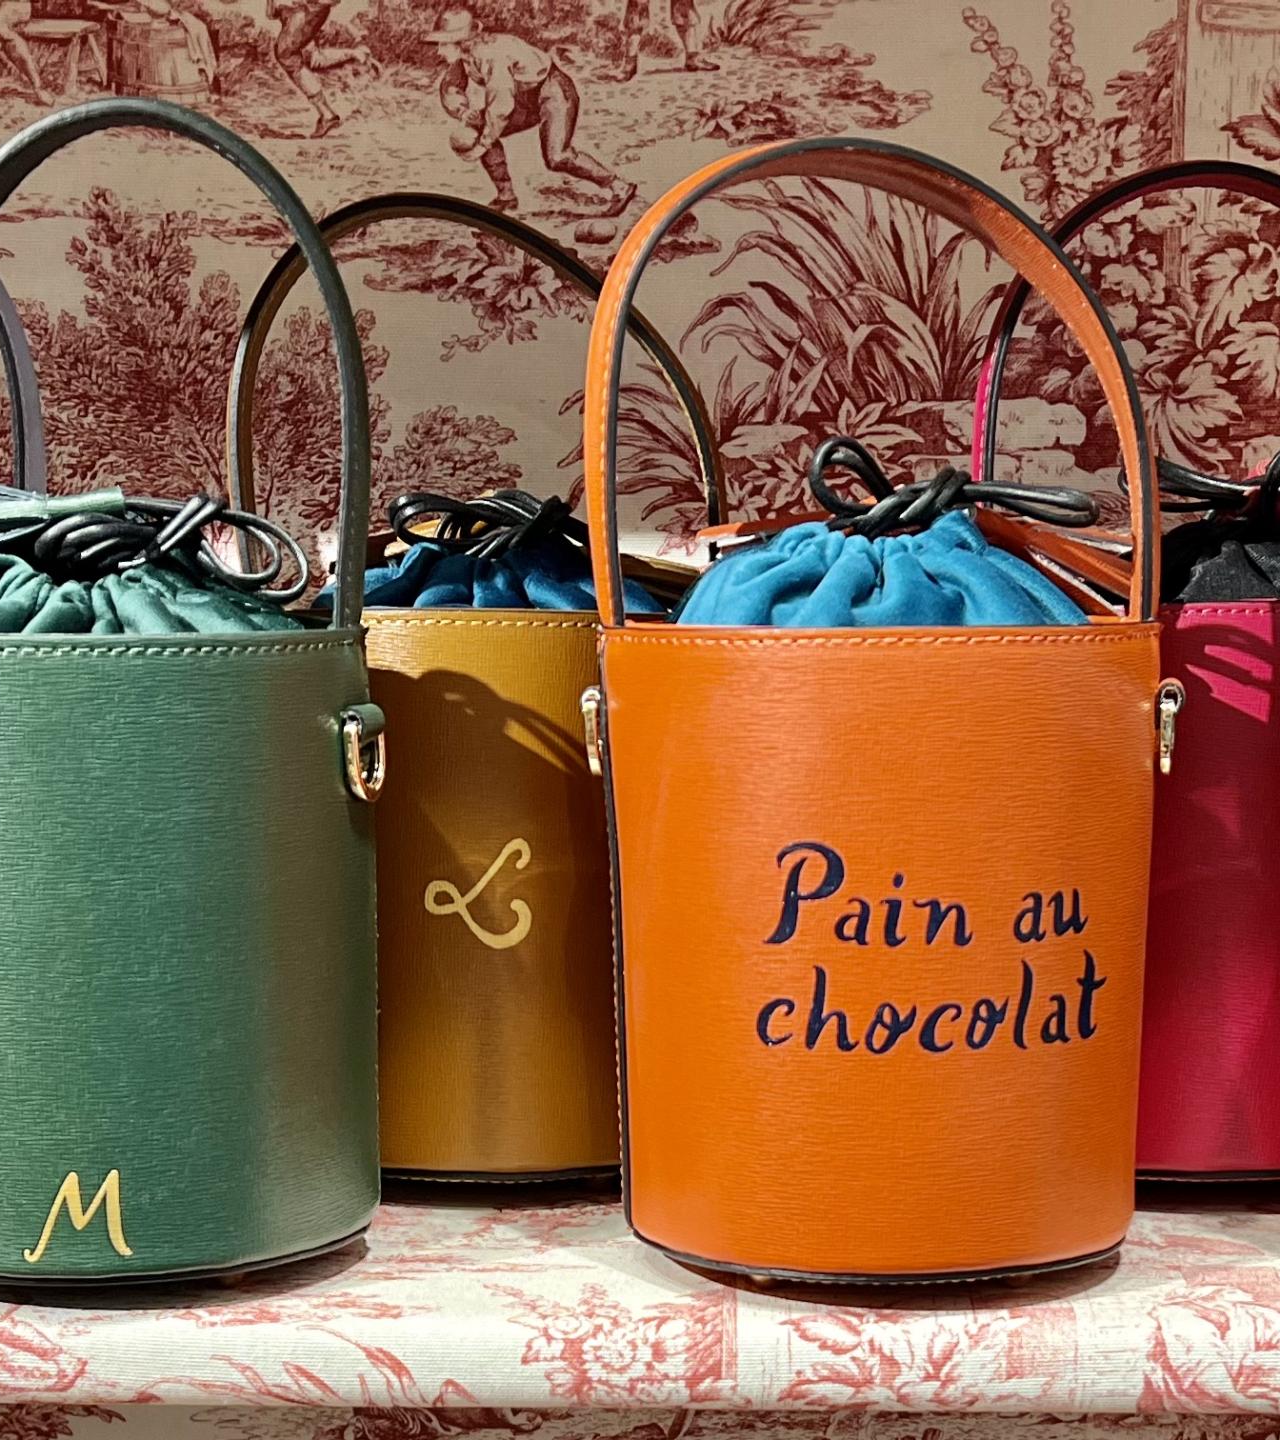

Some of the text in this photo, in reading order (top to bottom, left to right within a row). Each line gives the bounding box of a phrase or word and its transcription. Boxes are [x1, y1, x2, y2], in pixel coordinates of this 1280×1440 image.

[763, 841, 1089, 947] Pain au
[755, 949, 1107, 1054] chocolat
[23, 1169, 134, 1264] M
